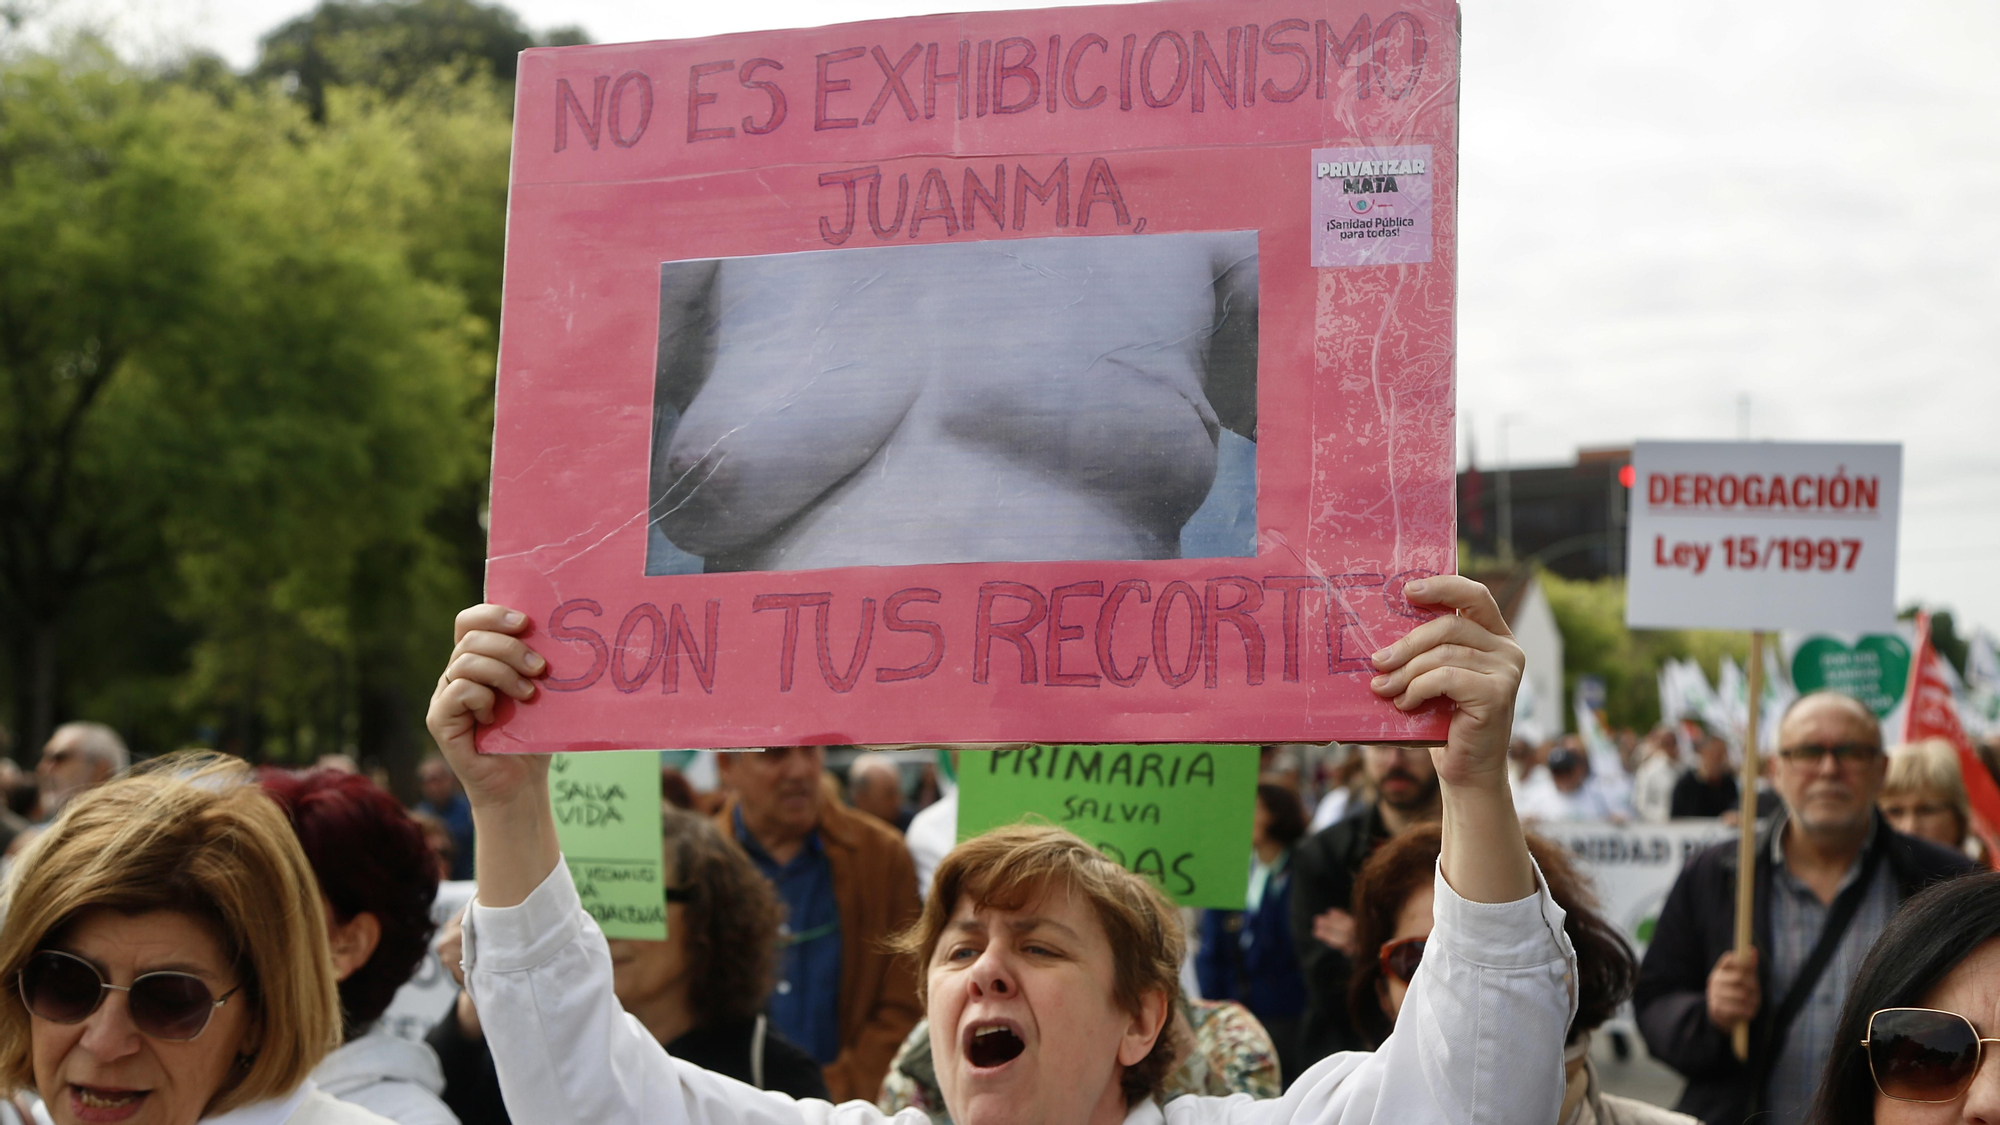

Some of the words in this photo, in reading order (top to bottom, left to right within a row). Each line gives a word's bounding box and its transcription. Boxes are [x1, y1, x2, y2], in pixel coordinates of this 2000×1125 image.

[554, 70, 653, 152] NO
[687, 57, 788, 144] ES
[814, 11, 1428, 131] EXHIBICIONISMO
[1317, 159, 1425, 178] PRIVATIZAR
[1343, 176, 1398, 194] MATA
[818, 156, 1148, 246] JUANMA,
[1327, 218, 1372, 231] ¡Sanidad
[1375, 216, 1414, 228] Pública
[1340, 230, 1364, 241] para
[1367, 227, 1400, 238] todas!
[1648, 464, 1880, 511] DEROGACIÓN
[1653, 533, 1711, 576] Ley
[1721, 535, 1864, 573] 15/1997
[539, 597, 721, 695] SON
[752, 587, 946, 694] TUS
[988, 745, 1215, 788] PRIMARIA
[553, 778, 627, 803] SALVA
[555, 803, 625, 828] VIDA
[1061, 794, 1161, 825] SALVA
